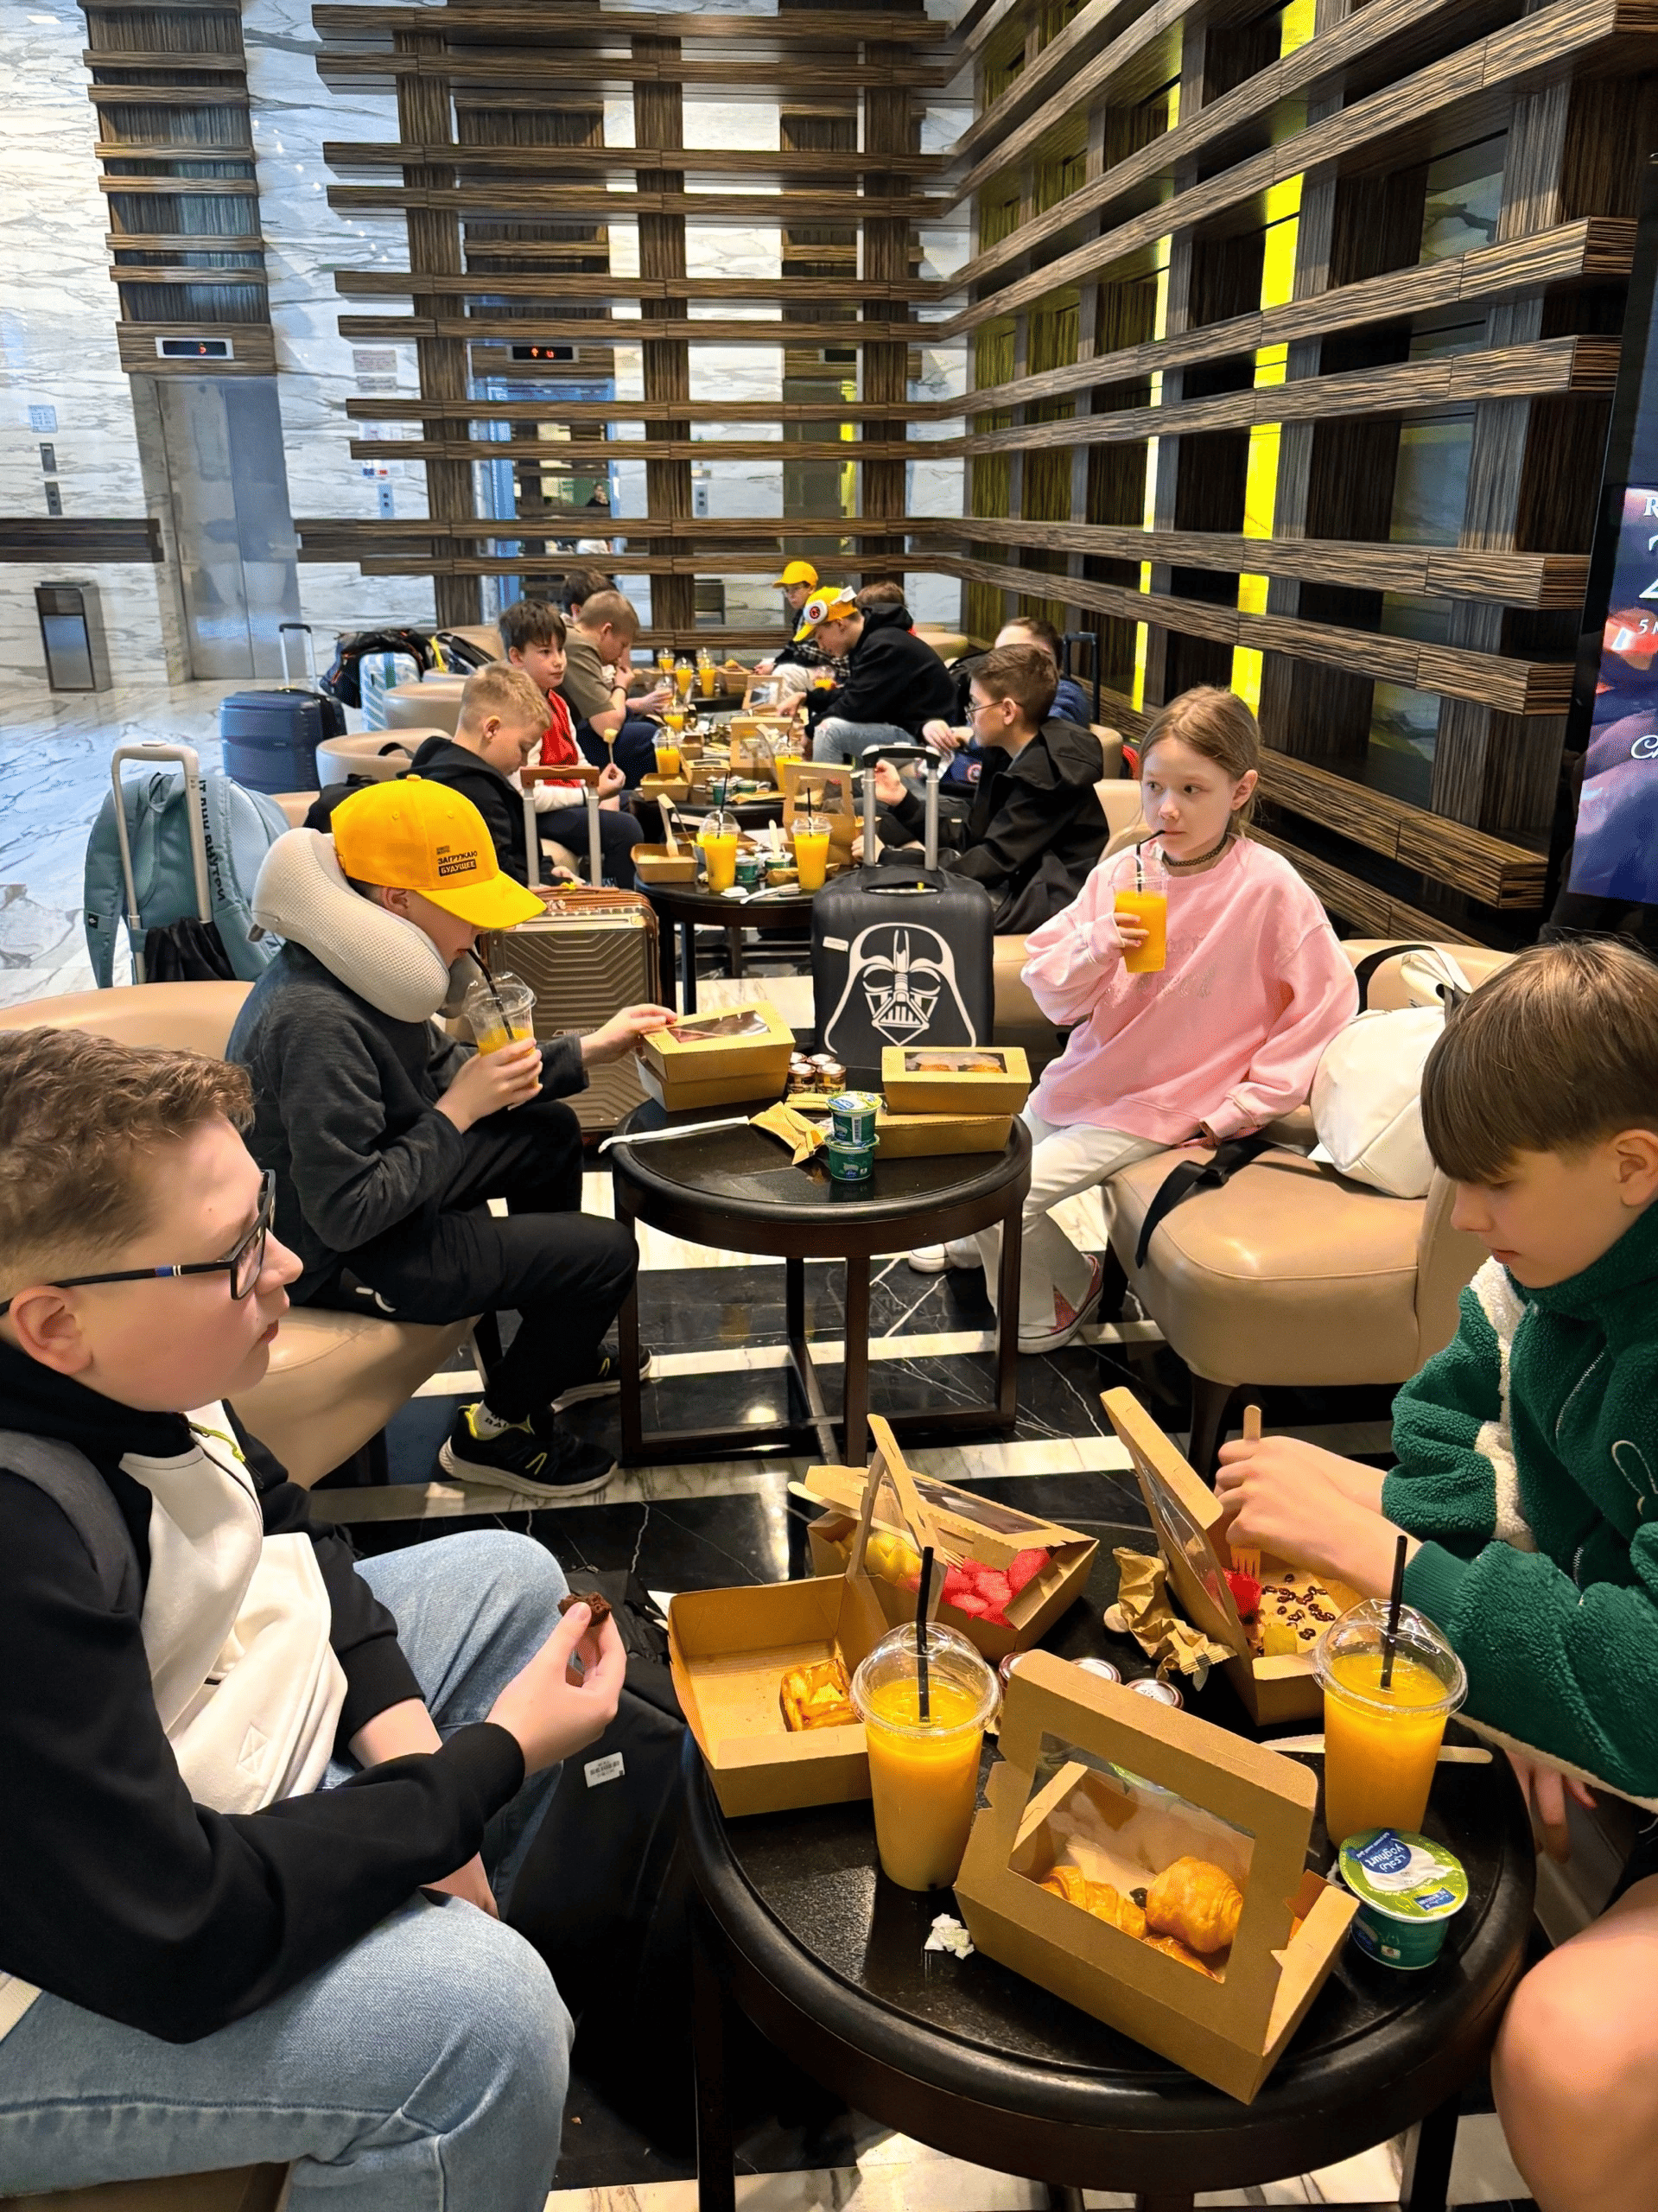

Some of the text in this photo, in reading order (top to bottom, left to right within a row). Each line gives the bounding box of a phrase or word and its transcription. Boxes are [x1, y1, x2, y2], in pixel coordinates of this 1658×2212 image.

[437, 850, 478, 865] ЗАГРУЖАЮ
[441, 861, 476, 874] БУДУЩЕЕ
[1364, 1842, 1404, 1867] yoghurt
